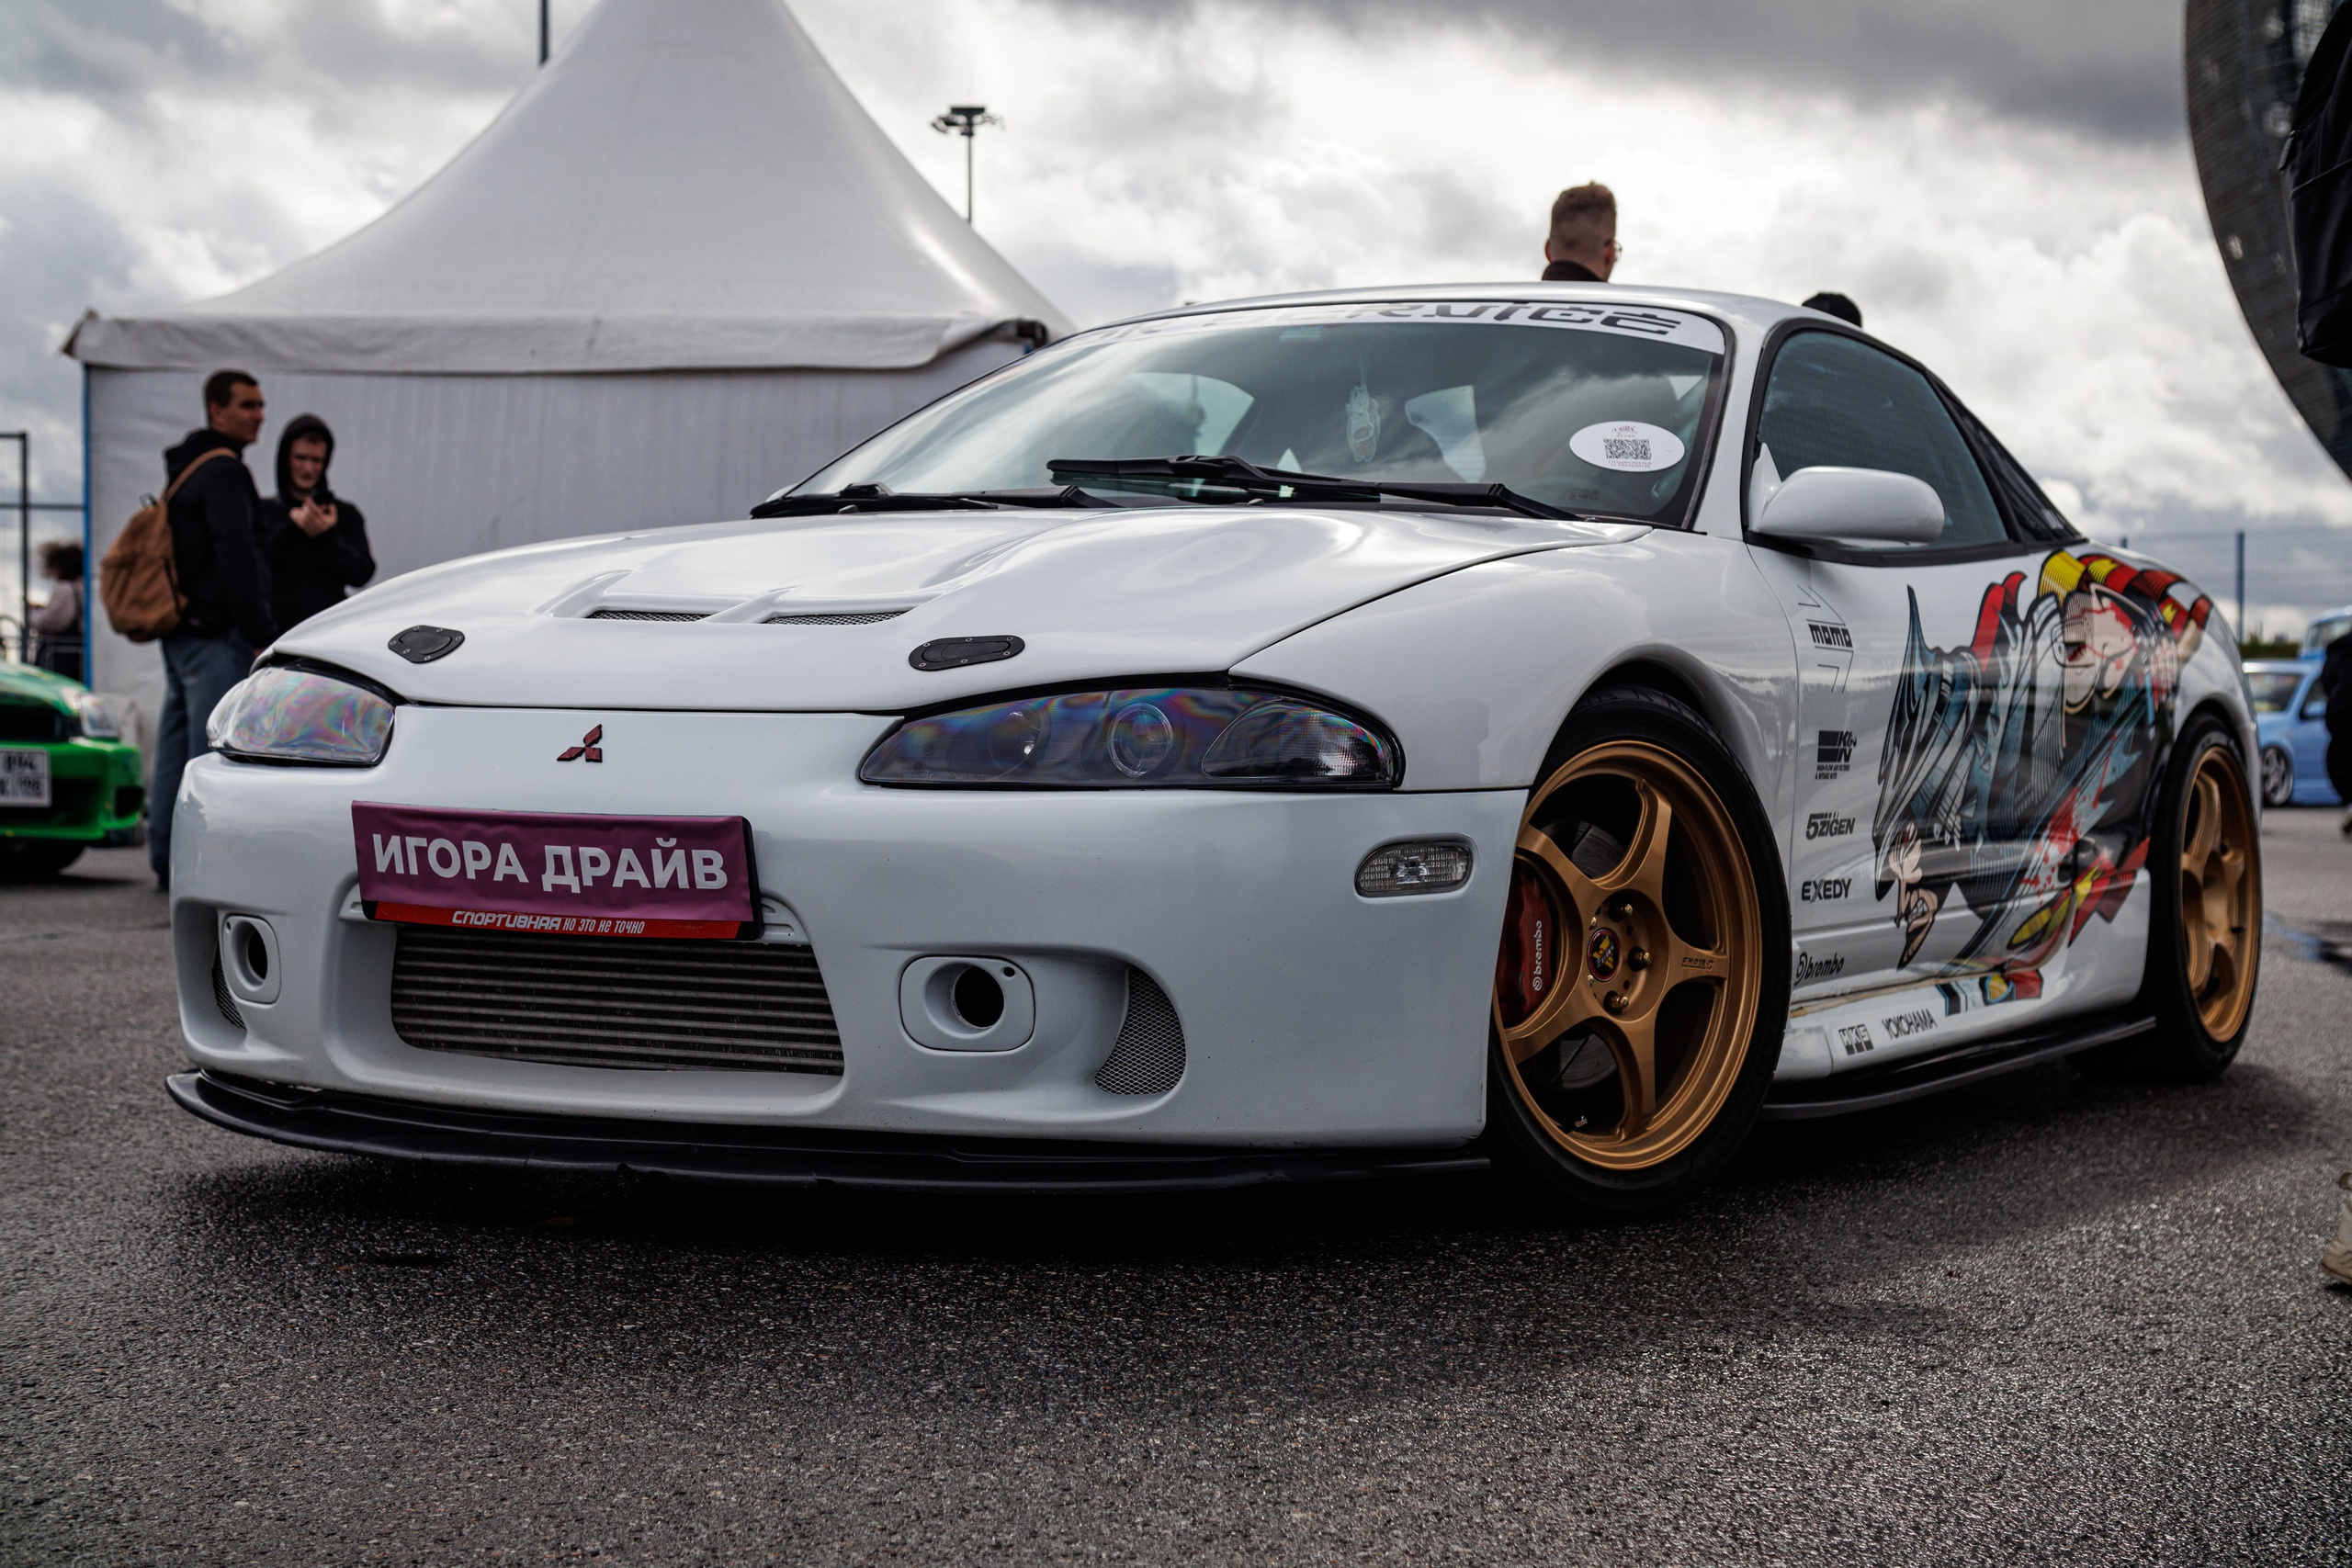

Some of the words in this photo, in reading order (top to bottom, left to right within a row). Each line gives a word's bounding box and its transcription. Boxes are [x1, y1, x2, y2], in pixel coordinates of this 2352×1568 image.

[1805, 811, 1856, 840] 5ZIGEN
[372, 833, 529, 884] ИГОРА
[541, 837, 729, 894] ДРАЙВ
[1801, 878, 1852, 903] EXEDY
[1533, 920, 1543, 976] brembo
[1804, 953, 1845, 980] brembo
[1838, 1022, 1874, 1056] HKS
[1882, 1008, 1939, 1040] YOKOHAMA
